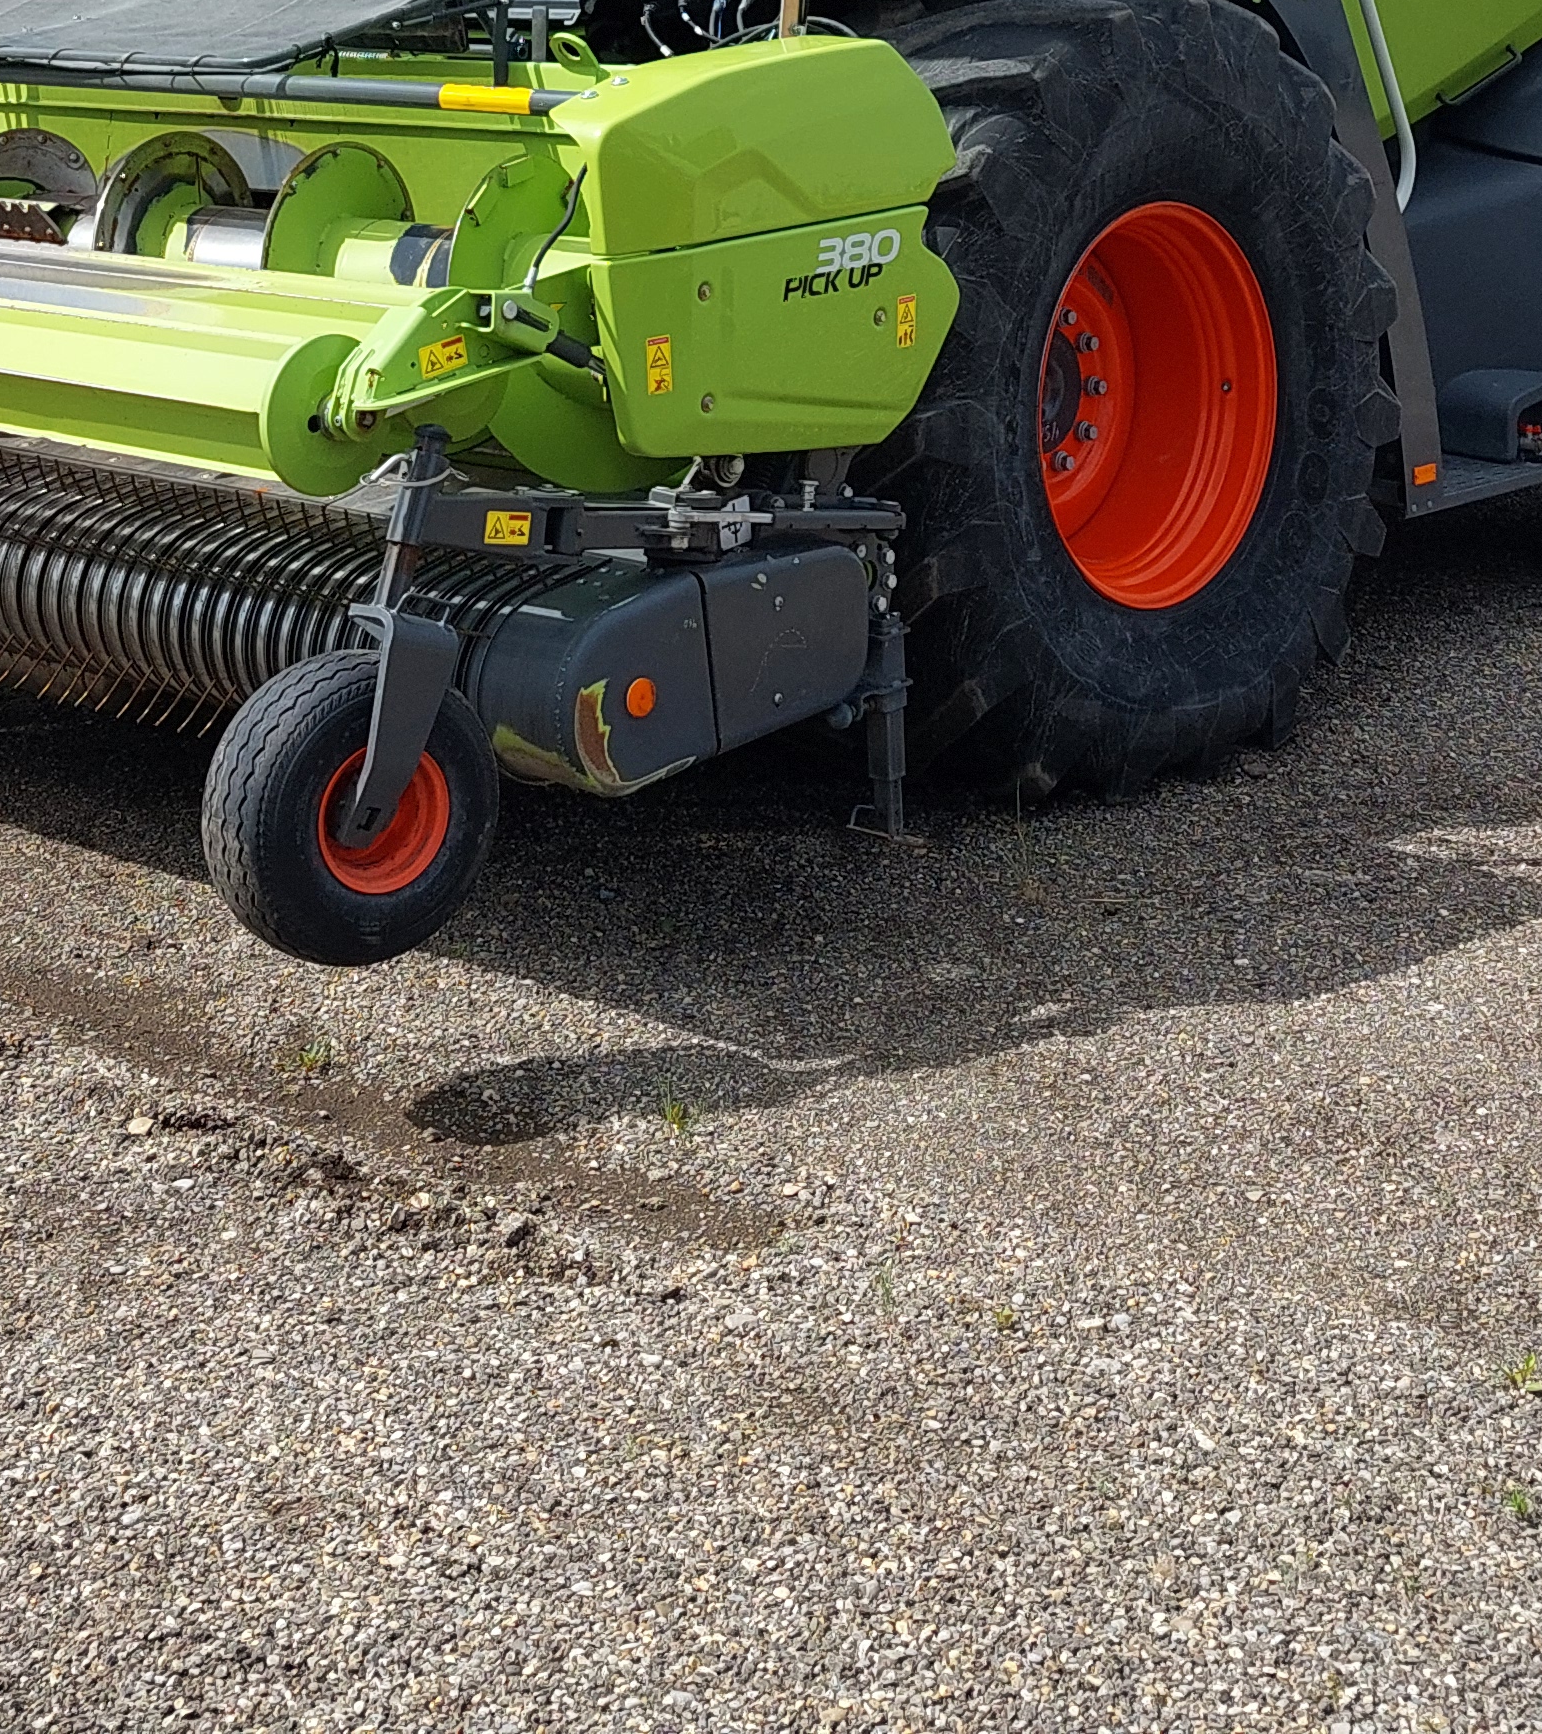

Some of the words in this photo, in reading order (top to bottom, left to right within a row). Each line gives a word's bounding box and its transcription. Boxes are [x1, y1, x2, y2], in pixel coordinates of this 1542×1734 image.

[815, 228, 901, 274] 380
[782, 268, 844, 303] PICK
[847, 262, 884, 289] UP
